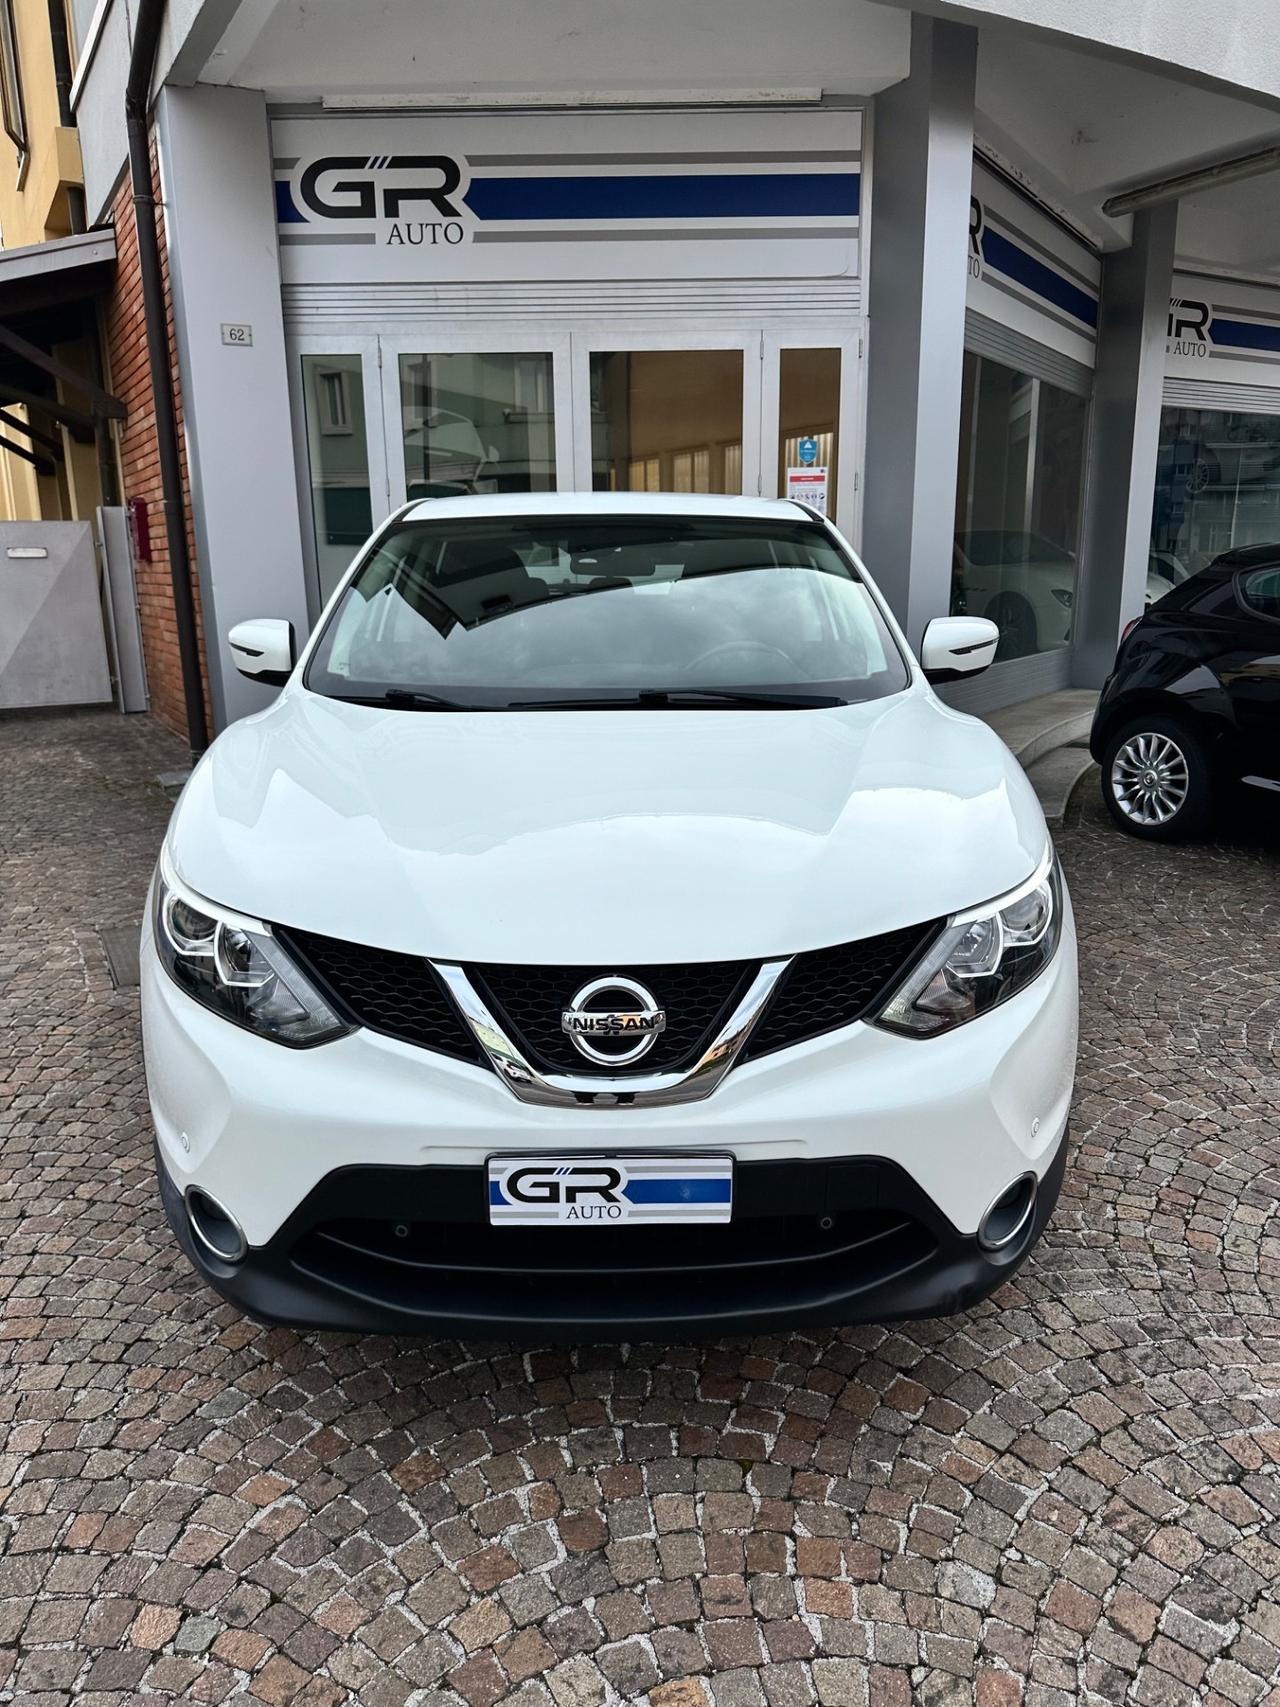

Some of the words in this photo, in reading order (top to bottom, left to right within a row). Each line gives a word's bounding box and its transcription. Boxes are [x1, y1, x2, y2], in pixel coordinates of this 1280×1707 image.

[300, 155, 463, 219] GR
[386, 222, 464, 245] AUTO
[230, 328, 245, 341] 62
[1173, 341, 1207, 357] AUTO
[572, 1016, 655, 1031] NISSAN
[506, 1166, 622, 1203] GR
[566, 1205, 622, 1219] AUTO
